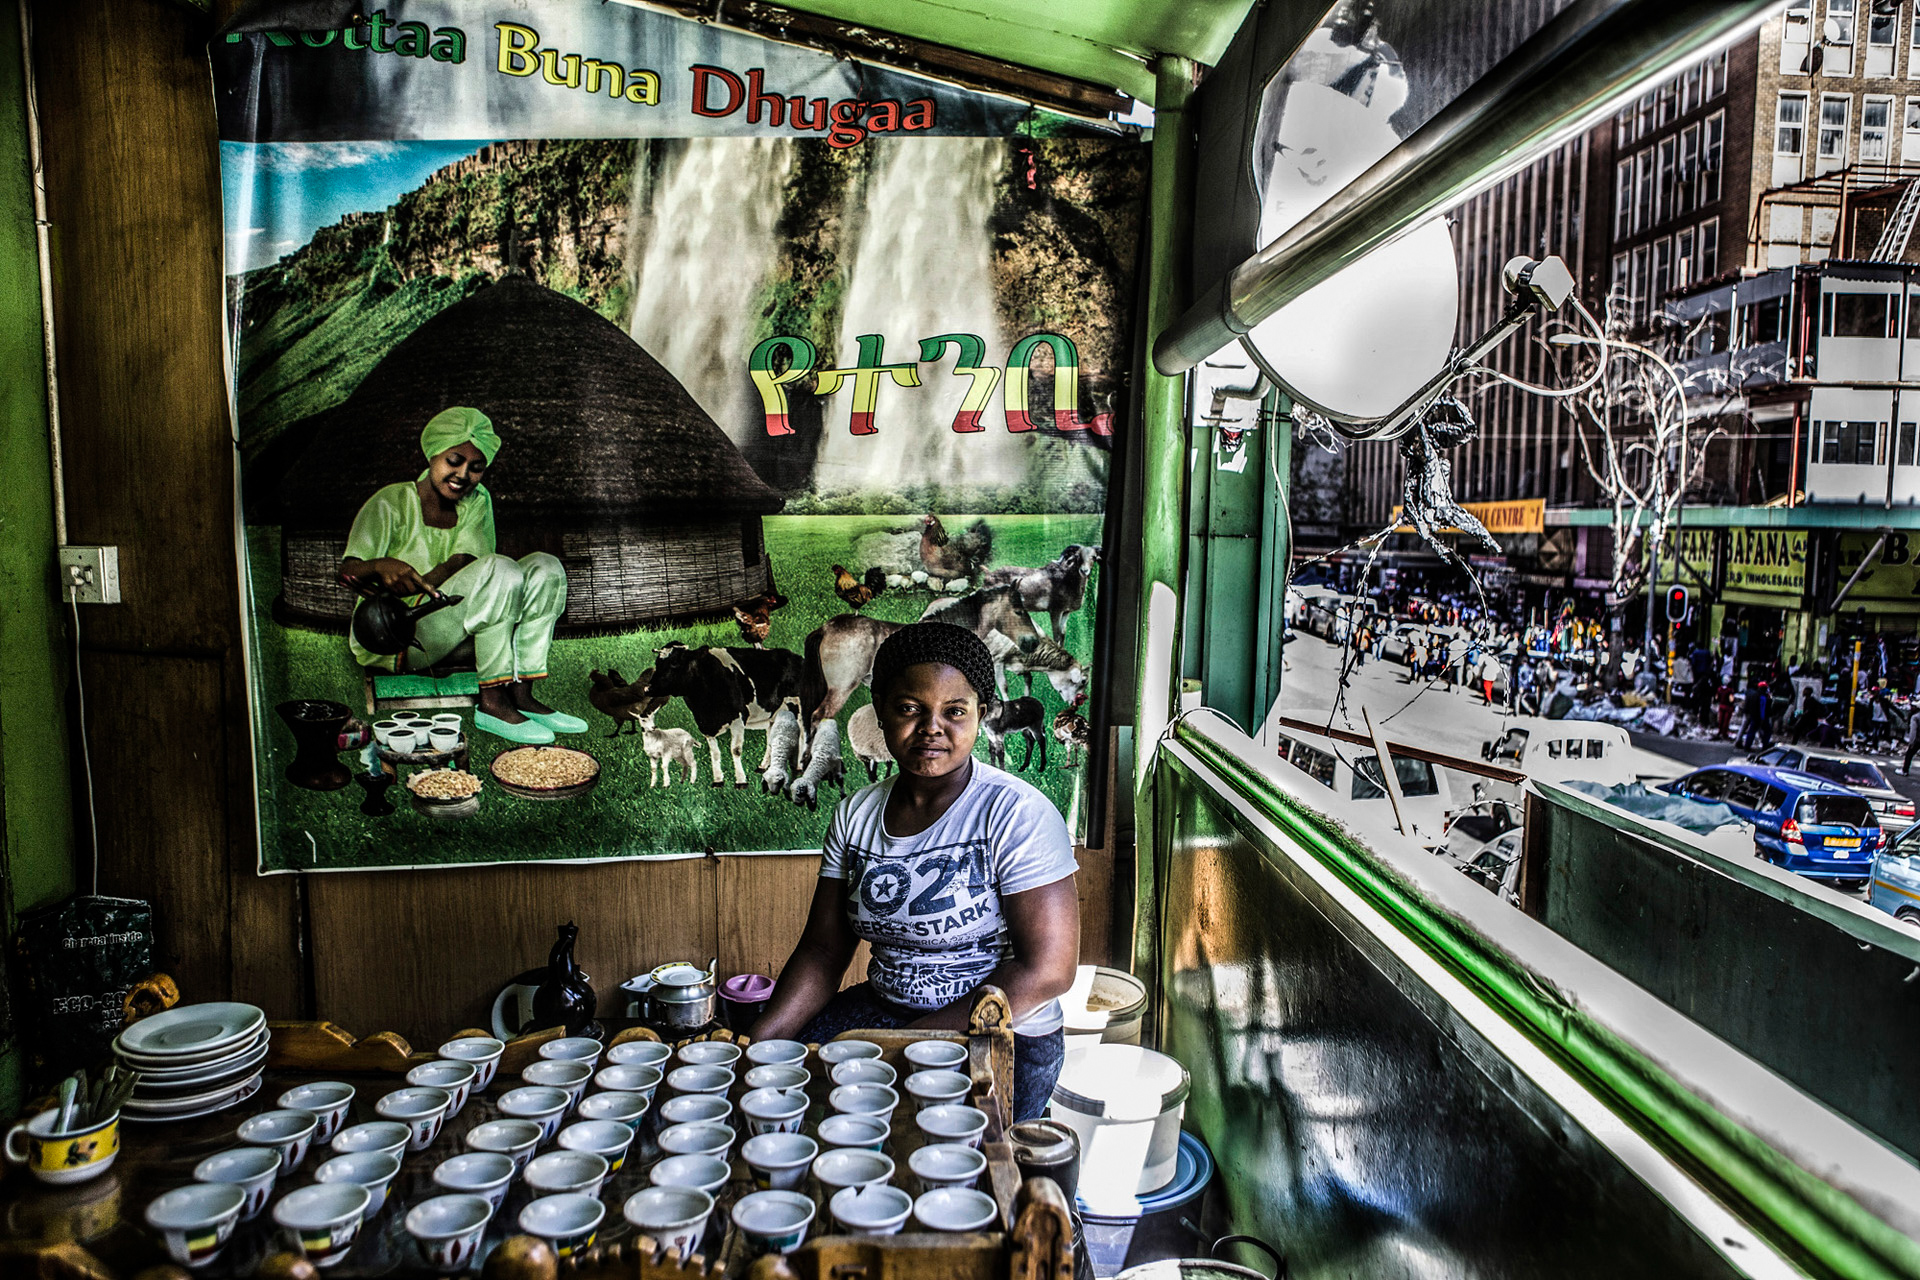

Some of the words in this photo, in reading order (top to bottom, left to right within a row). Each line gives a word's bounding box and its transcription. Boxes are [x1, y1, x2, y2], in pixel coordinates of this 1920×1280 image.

[494, 21, 661, 106] Buna
[689, 63, 937, 149] Dhugaa
[1490, 506, 1526, 528] CENTRE
[1727, 531, 1790, 567] BAFANA
[914, 898, 992, 937] STARK
[62, 934, 108, 950] Charcoal
[108, 930, 143, 945] inside
